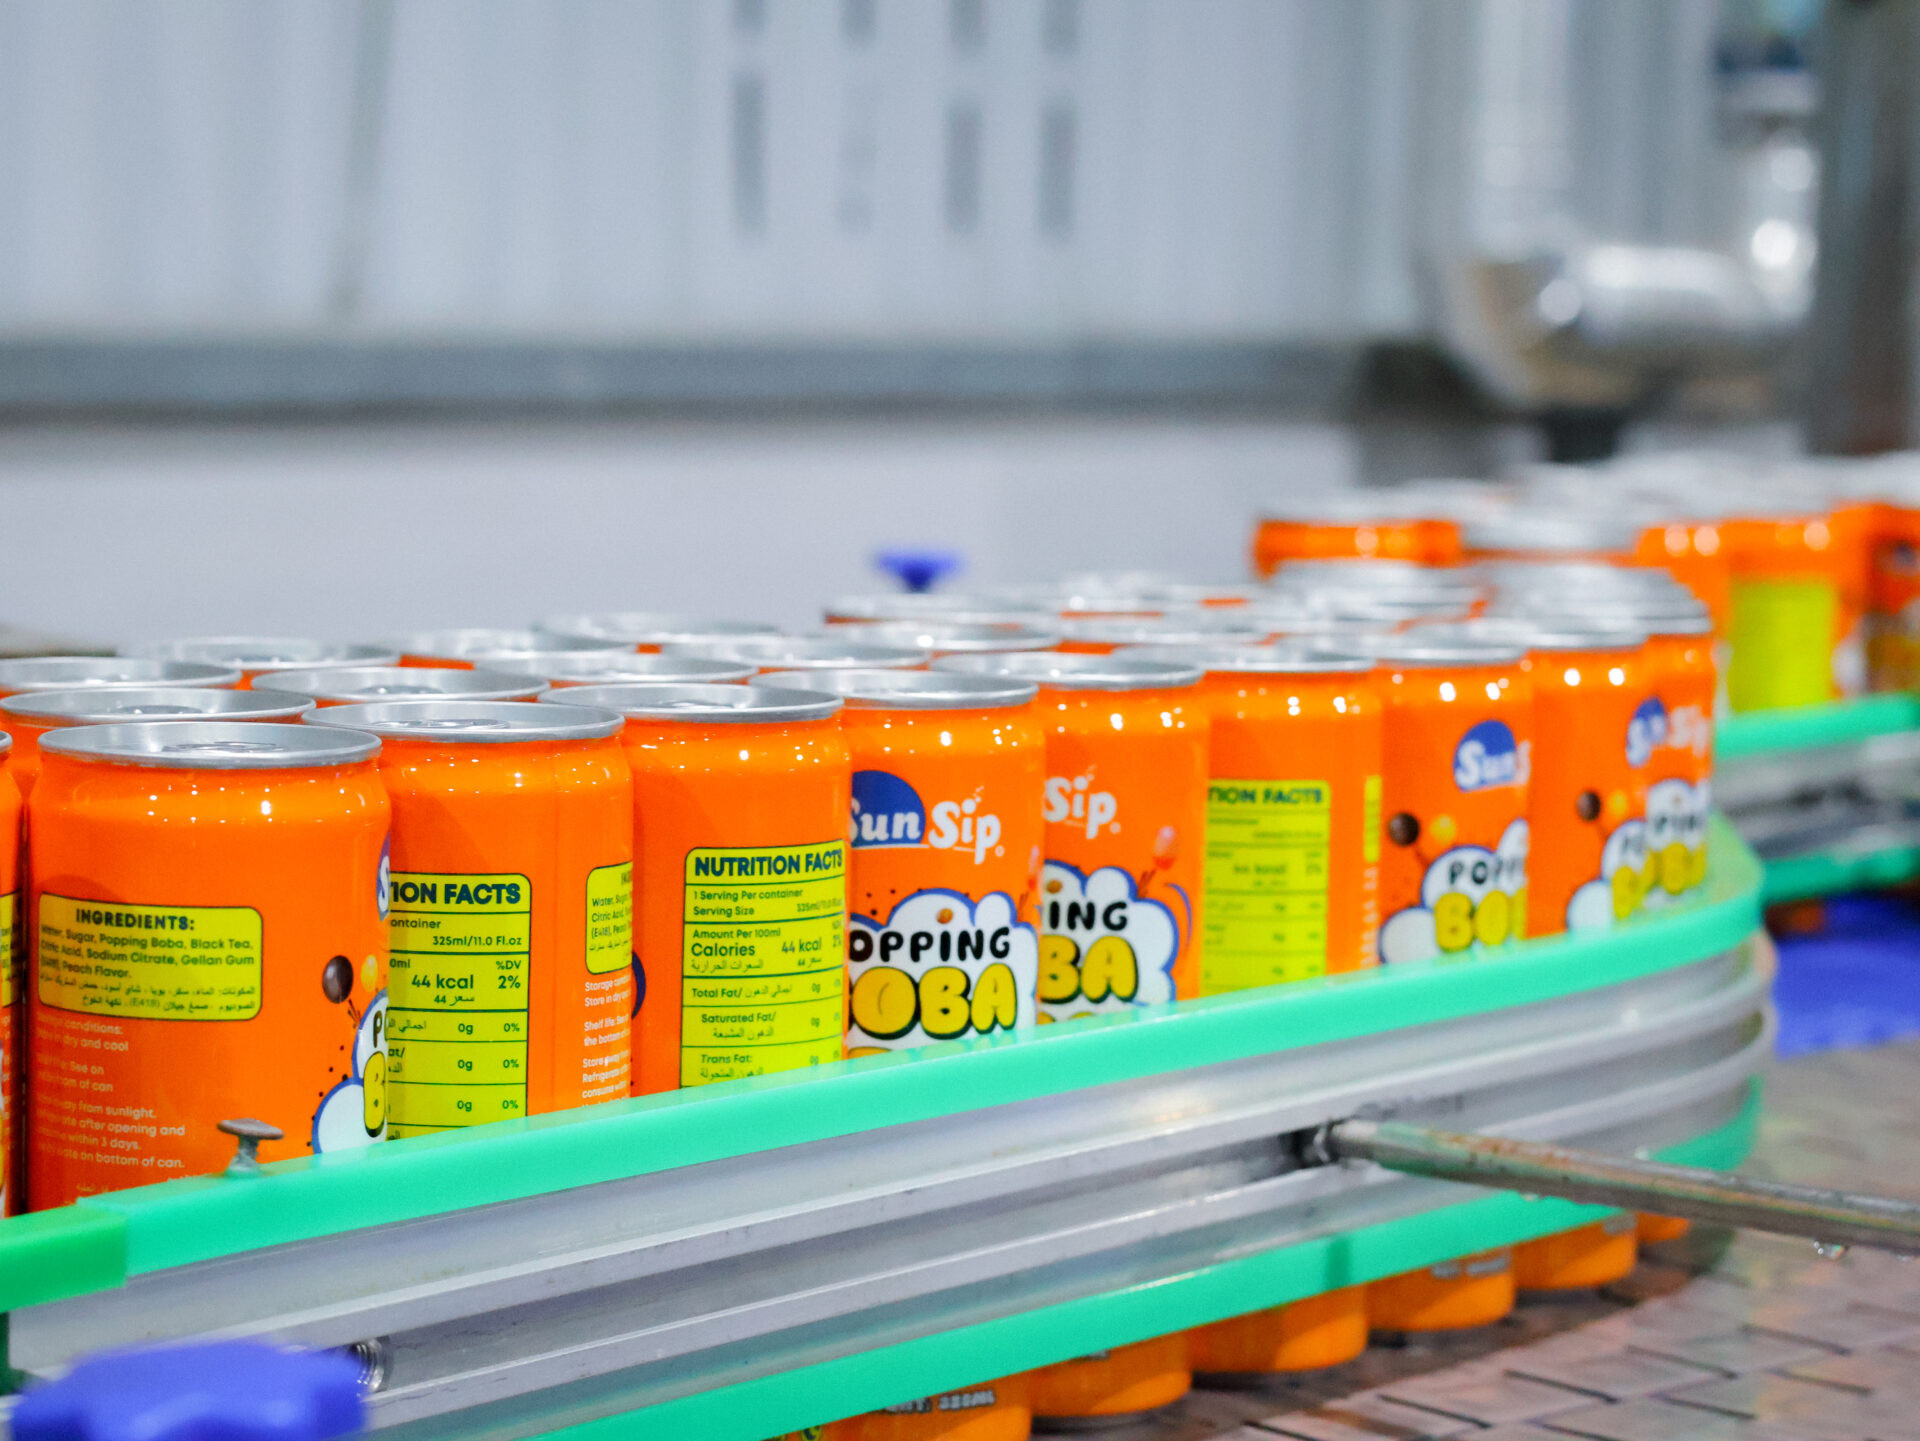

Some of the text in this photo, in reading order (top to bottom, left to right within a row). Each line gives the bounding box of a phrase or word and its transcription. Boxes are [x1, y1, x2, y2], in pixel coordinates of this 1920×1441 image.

[928, 797, 1001, 865] Sip
[694, 848, 843, 877] NUTRITION FACTS
[443, 882, 522, 905] FACTS
[699, 890, 739, 902] Serving
[741, 890, 757, 900] Per
[758, 888, 804, 900] container
[693, 905, 755, 918] Serving Size
[1048, 901, 1128, 931] ING
[75, 908, 195, 931] INGREDIENTS:
[389, 917, 442, 929] ontainer
[692, 927, 781, 939] Amount Per 100ml
[99, 933, 148, 950] Popping
[150, 937, 187, 950] Boba,
[190, 938, 225, 950] Black
[228, 938, 254, 950] Tea,
[432, 934, 523, 948] 325ml/11.0 Fl.oz
[691, 937, 823, 957] Calories 44 kcal
[850, 926, 1011, 963] OPPING
[86, 948, 128, 961] Sodium
[130, 951, 178, 967] Citrate,
[181, 954, 223, 966] Gellan
[225, 954, 255, 966] Gum
[389, 957, 411, 969] 0ml
[495, 959, 522, 970] %DV
[62, 960, 93, 976] Peach
[94, 965, 132, 979] Flavor.
[1040, 935, 1138, 1004] BA
[411, 973, 521, 989] 44 kcal 2%
[433, 994, 447, 1004] 44
[691, 986, 743, 999] Total Fat/
[850, 962, 1018, 1040] OBA
[701, 1011, 777, 1024] Saturated Fat/
[457, 1022, 521, 1036] 0g 0%
[81, 1037, 101, 1049] and
[103, 1041, 129, 1052] cool
[387, 1046, 405, 1058] at/
[457, 1058, 520, 1072] 0g 0%
[701, 1053, 732, 1065] Trans
[90, 1064, 105, 1075] on
[91, 1081, 113, 1092] can
[79, 1100, 104, 1114] from
[105, 1104, 157, 1120] sunlight.
[456, 1099, 519, 1113] 0g 0%
[79, 1117, 106, 1131] after
[107, 1121, 157, 1138] opening
[159, 1124, 186, 1137] and
[109, 1137, 142, 1152] days.
[95, 1151, 139, 1166] bottom
[141, 1156, 155, 1168] of
[156, 1158, 185, 1169] can.
